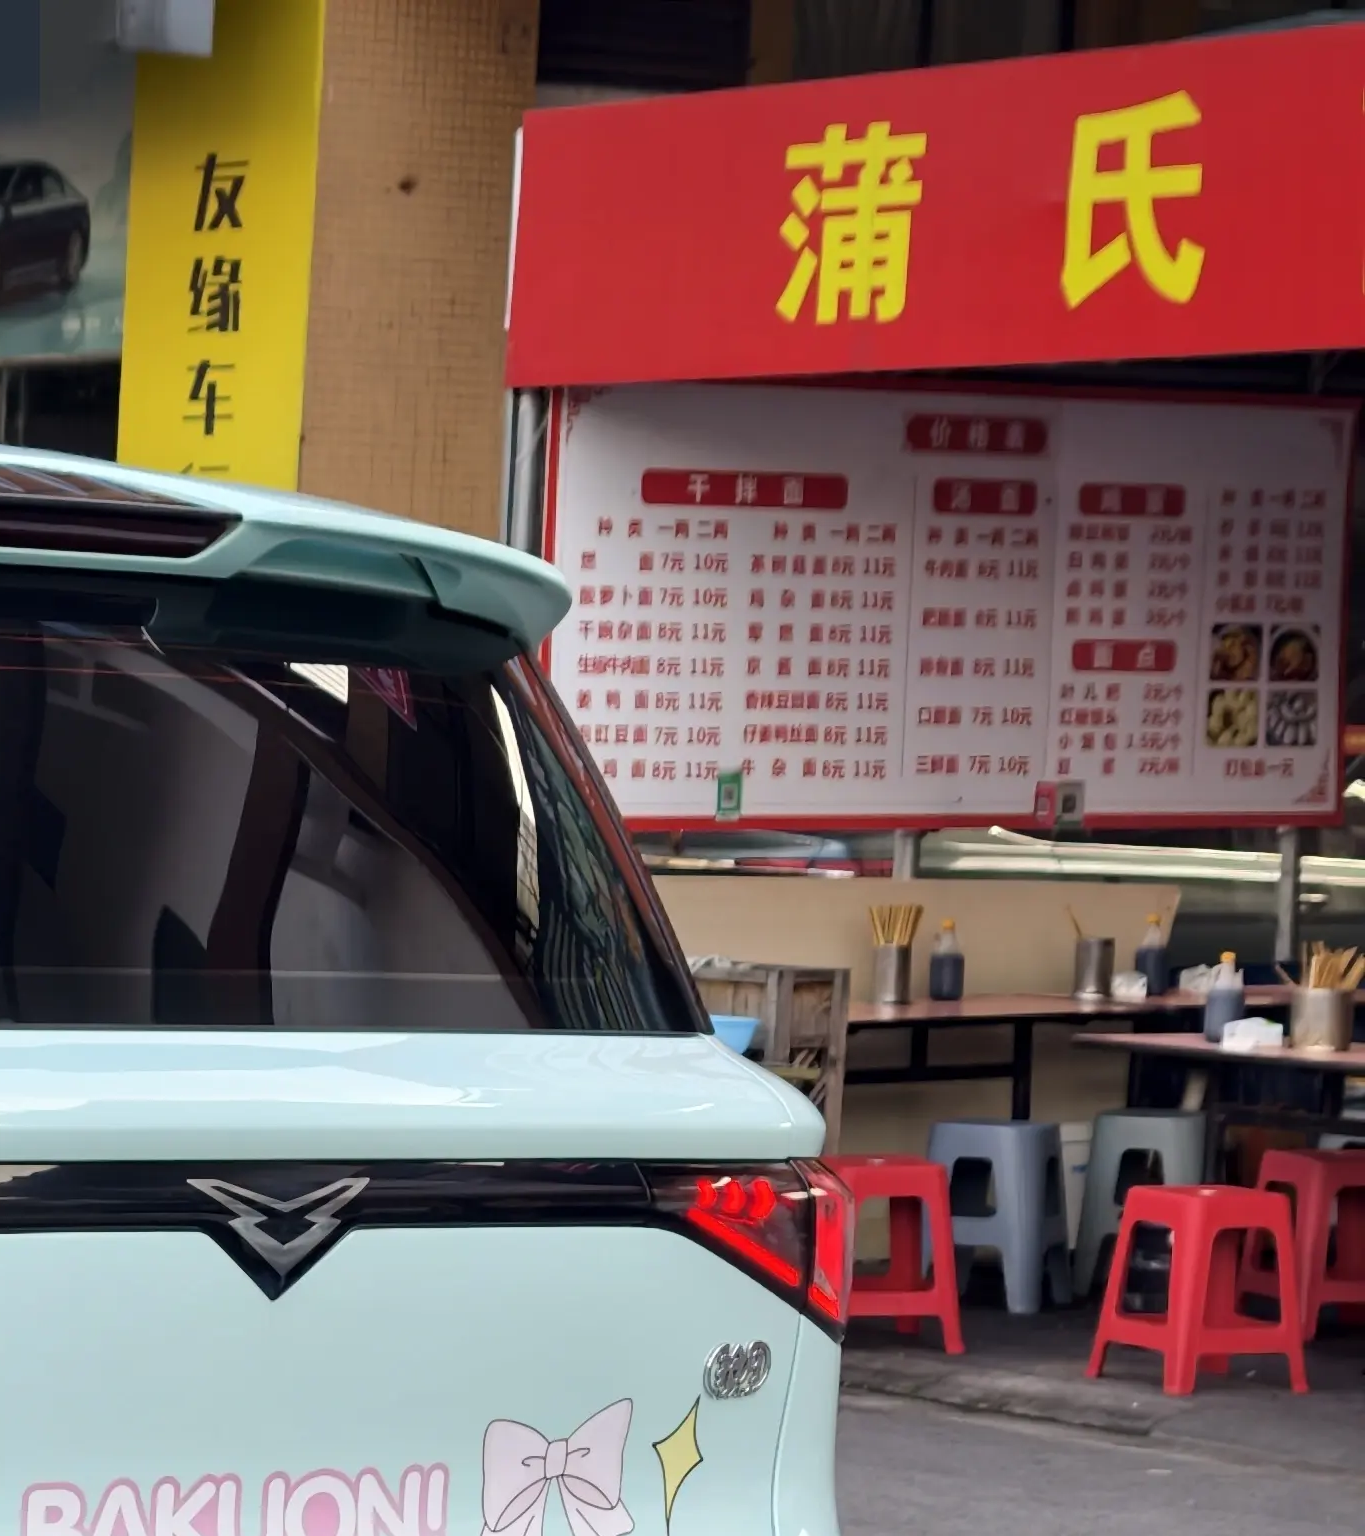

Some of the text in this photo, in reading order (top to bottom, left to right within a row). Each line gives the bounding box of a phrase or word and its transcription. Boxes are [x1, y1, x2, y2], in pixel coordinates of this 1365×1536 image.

[179, 152, 249, 474] 友缘车
[660, 552, 685, 573] 7元
[695, 552, 729, 573] 10元
[863, 556, 896, 577] 11元
[660, 586, 685, 607] 7元
[693, 587, 728, 608] 10元
[862, 590, 894, 611] 11元
[1006, 608, 1037, 629] 11元
[658, 621, 683, 642] 8元
[691, 622, 727, 643] 11元
[860, 624, 892, 644] 11元
[656, 656, 681, 676] 8元
[690, 657, 725, 677] 11元
[859, 658, 890, 678] 11元
[655, 691, 680, 711] 8元
[689, 691, 723, 712] 11元
[857, 692, 889, 712] 11元
[1001, 706, 1032, 727] 10元
[654, 726, 679, 746] 7元
[687, 726, 721, 746] 10元
[856, 726, 888, 746] 11元
[651, 760, 676, 780] 8元
[685, 760, 719, 781] 11元
[854, 760, 886, 780] 11元
[969, 754, 991, 775] 7元
[998, 755, 1029, 776] 10元
